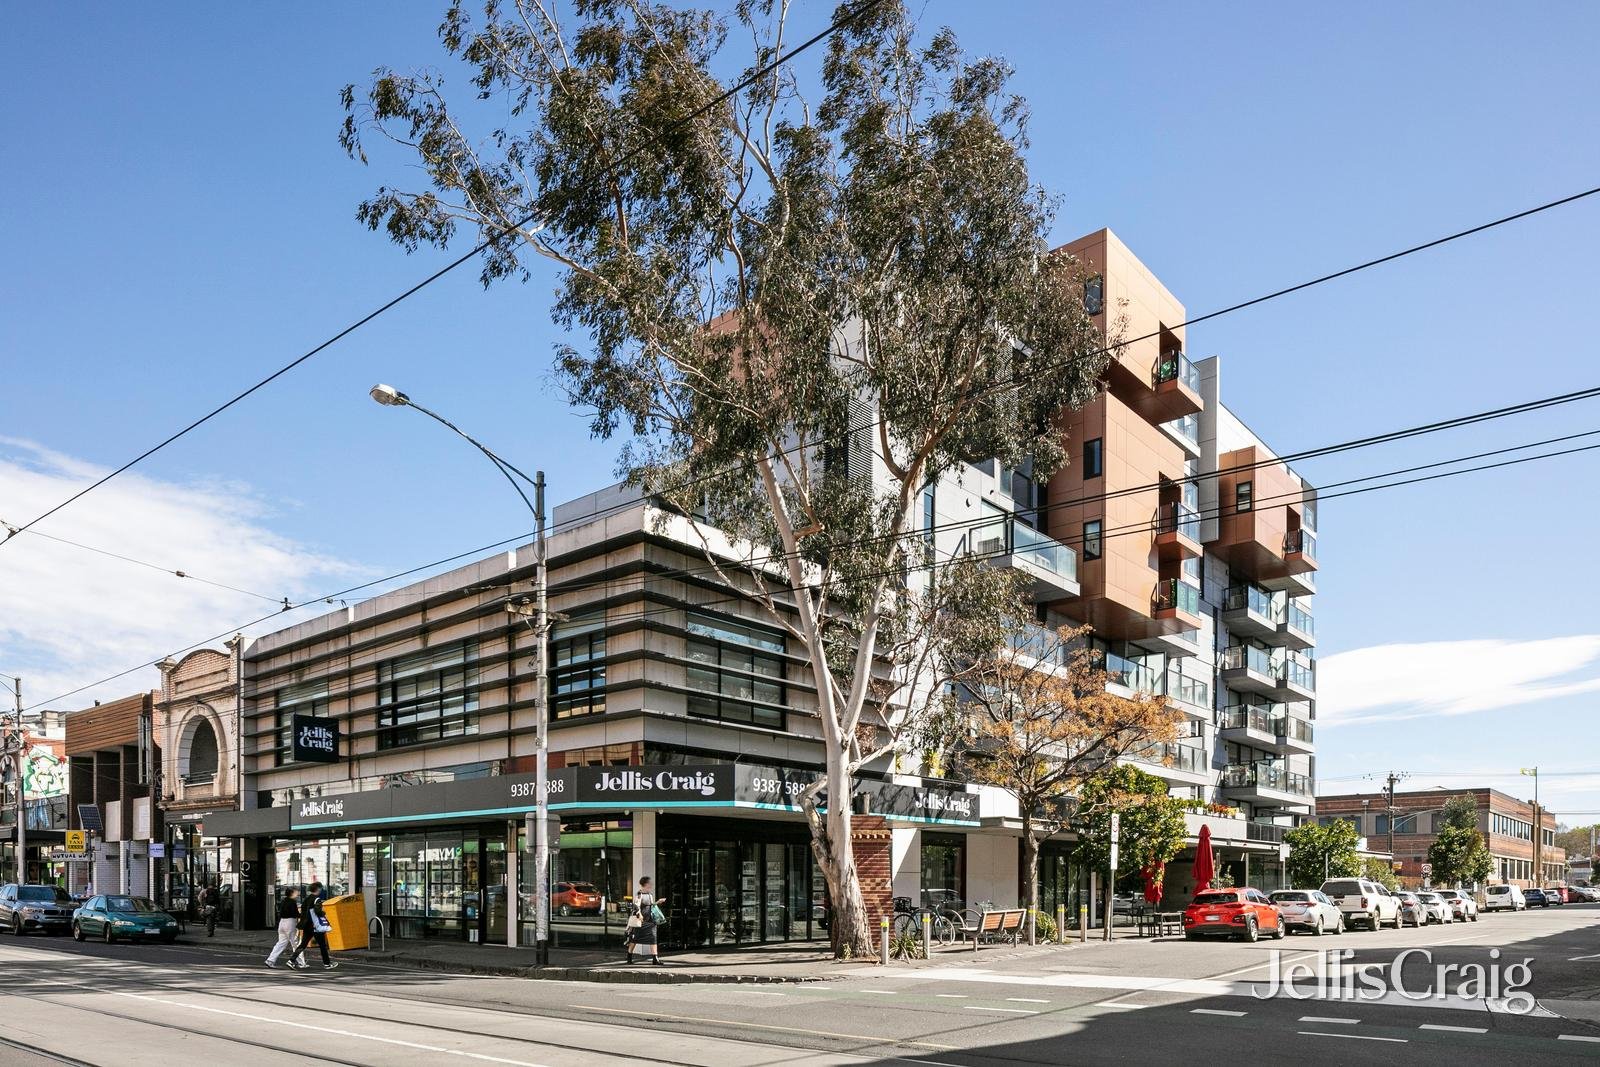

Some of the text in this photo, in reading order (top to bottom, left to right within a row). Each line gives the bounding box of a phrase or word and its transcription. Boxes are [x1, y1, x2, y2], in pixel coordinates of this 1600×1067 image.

[300, 726, 333, 739] Jellis
[299, 736, 333, 752] Craig
[511, 782, 535, 797] 9387
[595, 771, 716, 796] Jellis Craig
[753, 777, 781, 793] 9387
